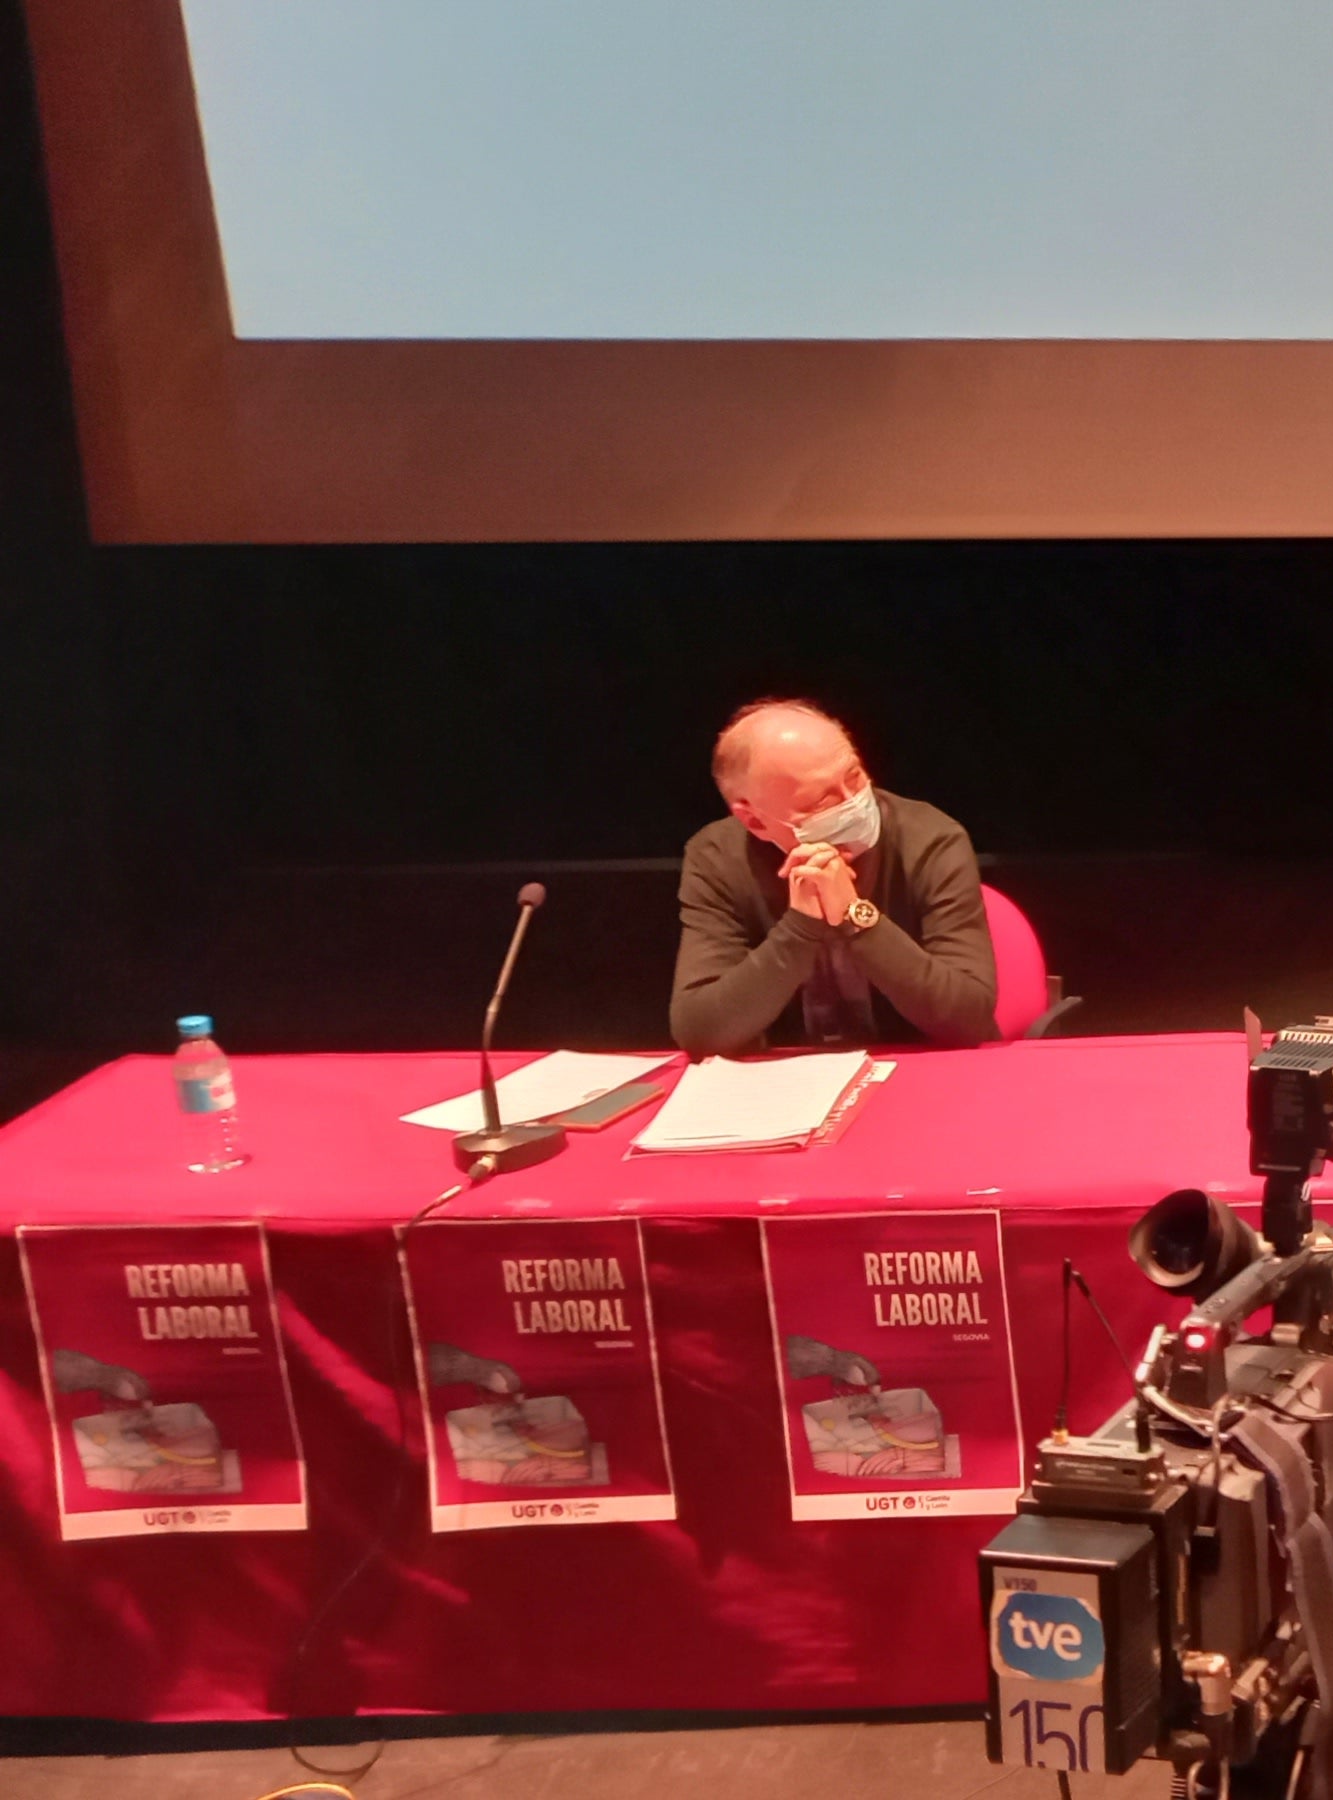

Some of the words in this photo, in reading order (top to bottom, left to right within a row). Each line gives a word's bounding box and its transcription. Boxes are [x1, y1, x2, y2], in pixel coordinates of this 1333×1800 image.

[124, 1263, 250, 1298] REFORMA
[502, 1258, 625, 1293] REFORMA
[864, 1250, 983, 1286] REFORMA
[137, 1305, 258, 1340] LABORAL
[514, 1299, 632, 1334] LABORAL
[874, 1292, 988, 1326] LABORAL
[143, 1511, 178, 1526] UGT
[511, 1504, 547, 1518] UGT
[865, 1496, 899, 1511] UGT
[1008, 1611, 1082, 1662] tve
